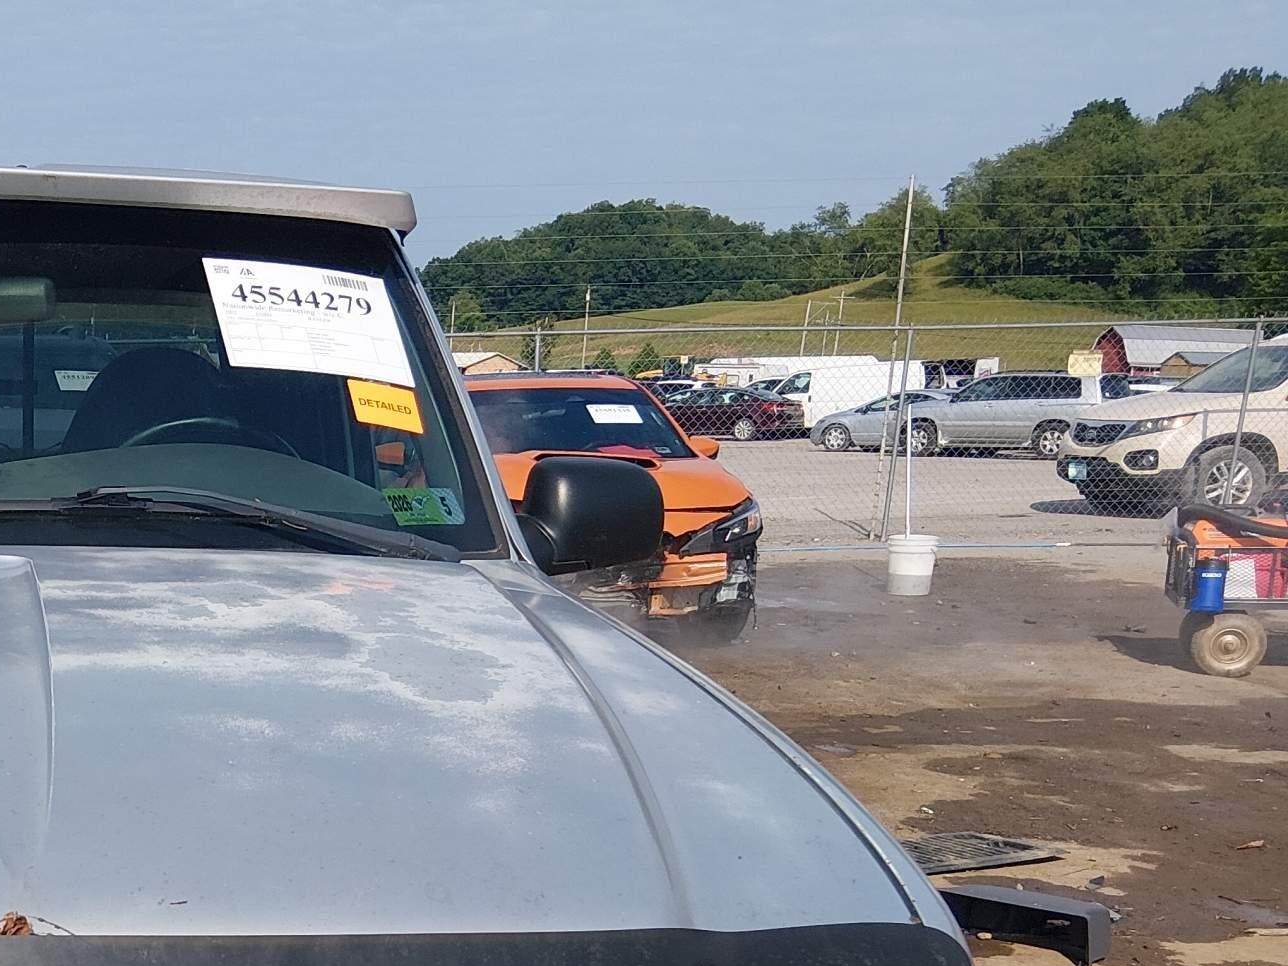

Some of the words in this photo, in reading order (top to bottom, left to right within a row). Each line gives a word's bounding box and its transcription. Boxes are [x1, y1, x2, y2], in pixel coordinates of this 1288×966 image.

[231, 283, 372, 316] 45544279
[358, 397, 412, 415] DETAILED
[438, 495, 454, 517] 5
